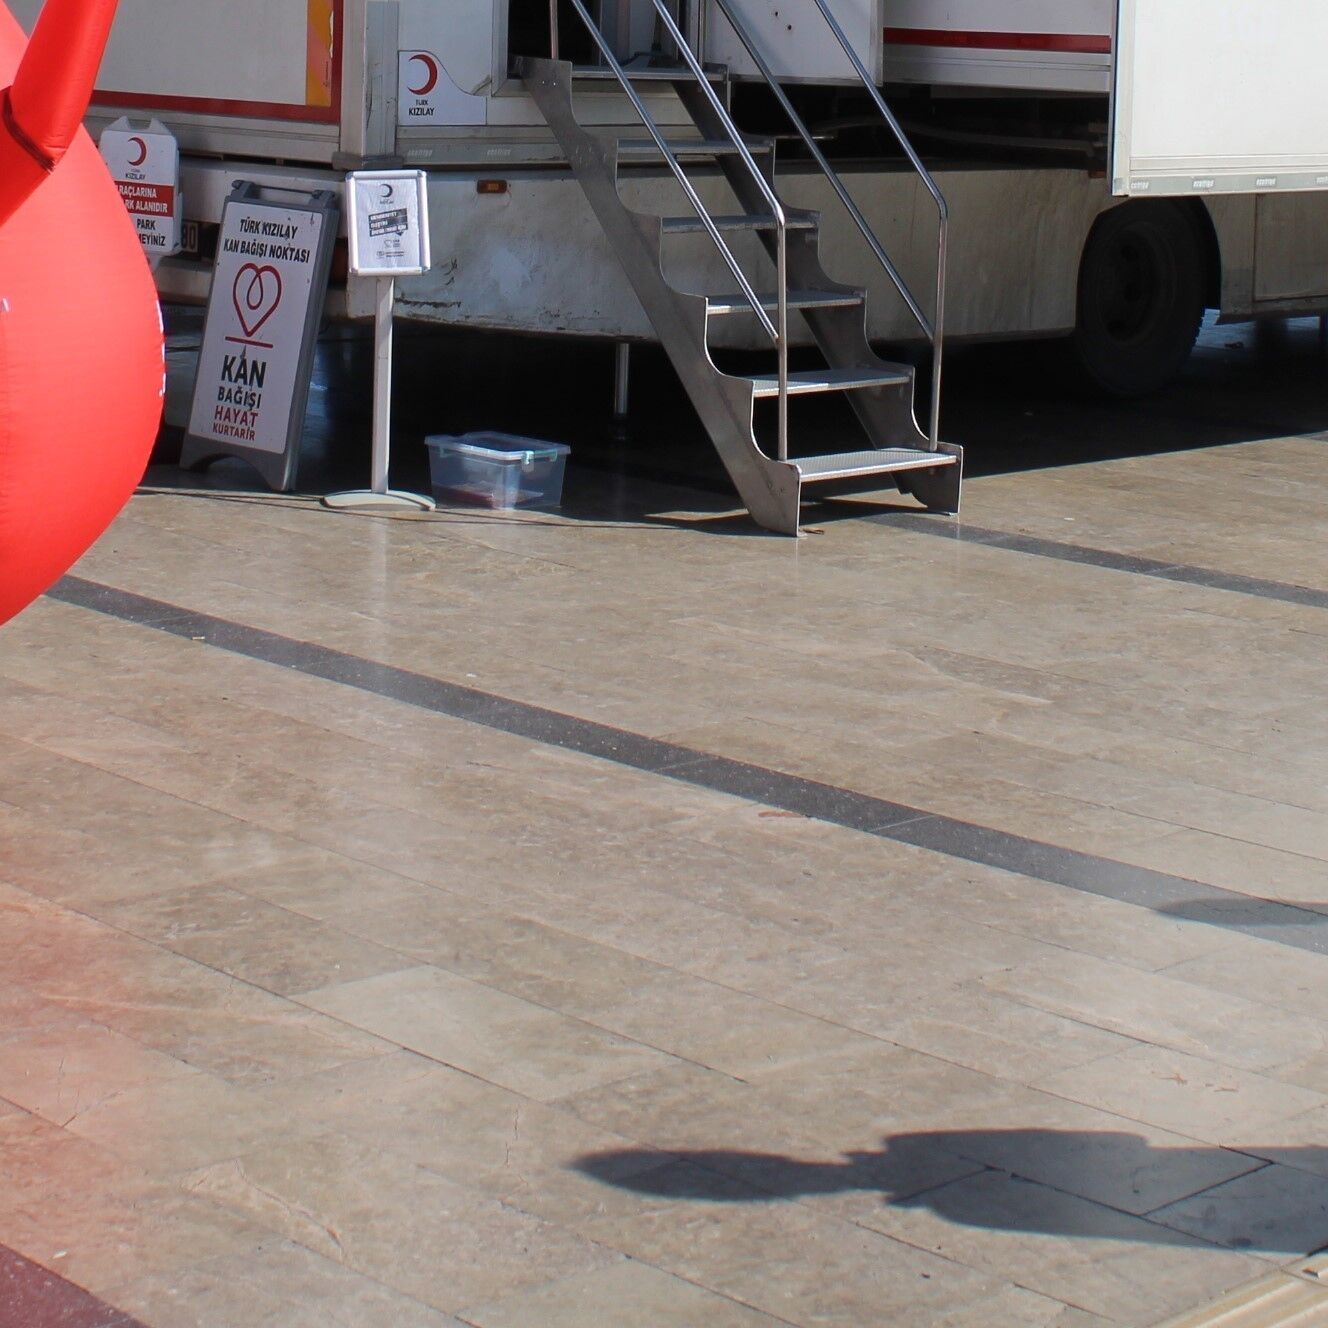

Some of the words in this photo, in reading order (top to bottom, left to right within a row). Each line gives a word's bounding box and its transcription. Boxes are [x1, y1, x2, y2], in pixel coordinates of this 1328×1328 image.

[408, 107, 435, 117] KIZILAY
[118, 185, 157, 198] RAÇLARINA
[124, 199, 135, 210] RK
[135, 201, 168, 213] ALANIDIR
[136, 218, 156, 231] PARK
[239, 216, 262, 234] TÜRK
[261, 221, 299, 240] KIZILAY
[223, 238, 241, 253] KAN
[240, 239, 268, 259] BAĞIŞI
[268, 243, 311, 264] NOKTASI
[221, 354, 267, 388] KAN
[217, 386, 262, 411] BAĞIŞI
[214, 405, 258, 428] HAYAT
